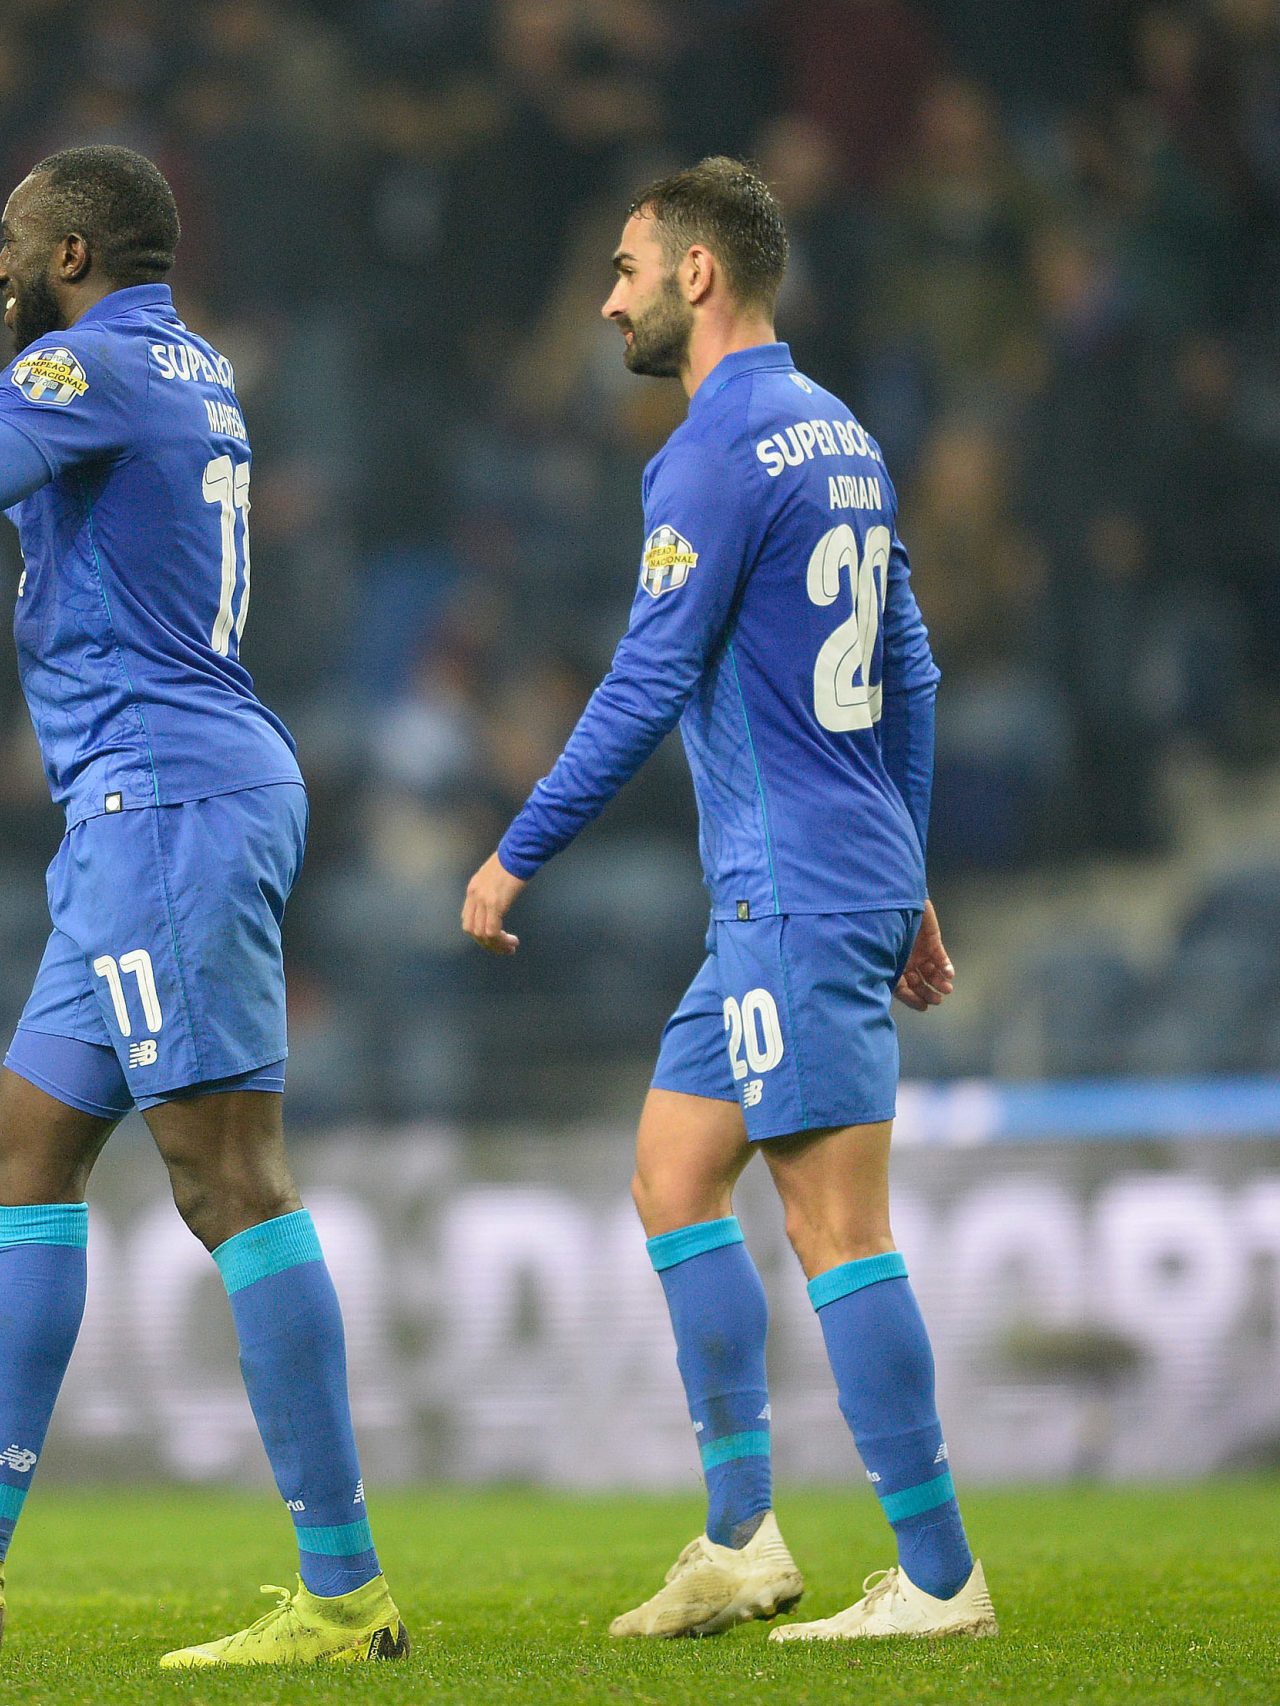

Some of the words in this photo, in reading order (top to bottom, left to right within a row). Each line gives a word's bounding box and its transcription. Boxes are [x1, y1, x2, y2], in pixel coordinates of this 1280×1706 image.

[33, 367, 84, 391] NACIONAL
[756, 419, 841, 477] SUPER
[828, 475, 882, 511] ADRIAN
[807, 523, 891, 732] 20
[93, 948, 163, 1037] 11
[723, 988, 784, 1080] 20
